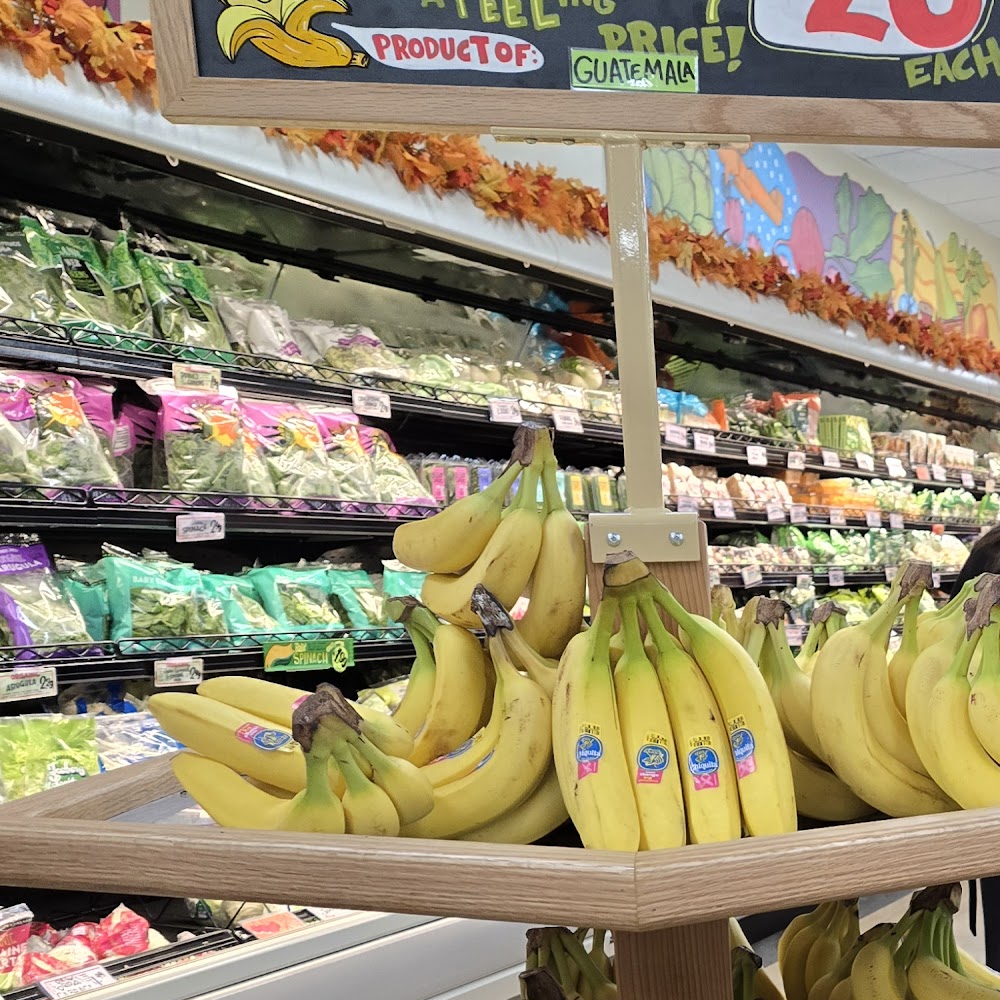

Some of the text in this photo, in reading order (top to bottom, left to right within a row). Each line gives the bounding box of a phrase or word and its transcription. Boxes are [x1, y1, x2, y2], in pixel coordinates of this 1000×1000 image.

[372, 33, 539, 67] PRODUCT OF:
[600, 20, 745, 73] PRICE!
[573, 55, 696, 86] GUATEMALA
